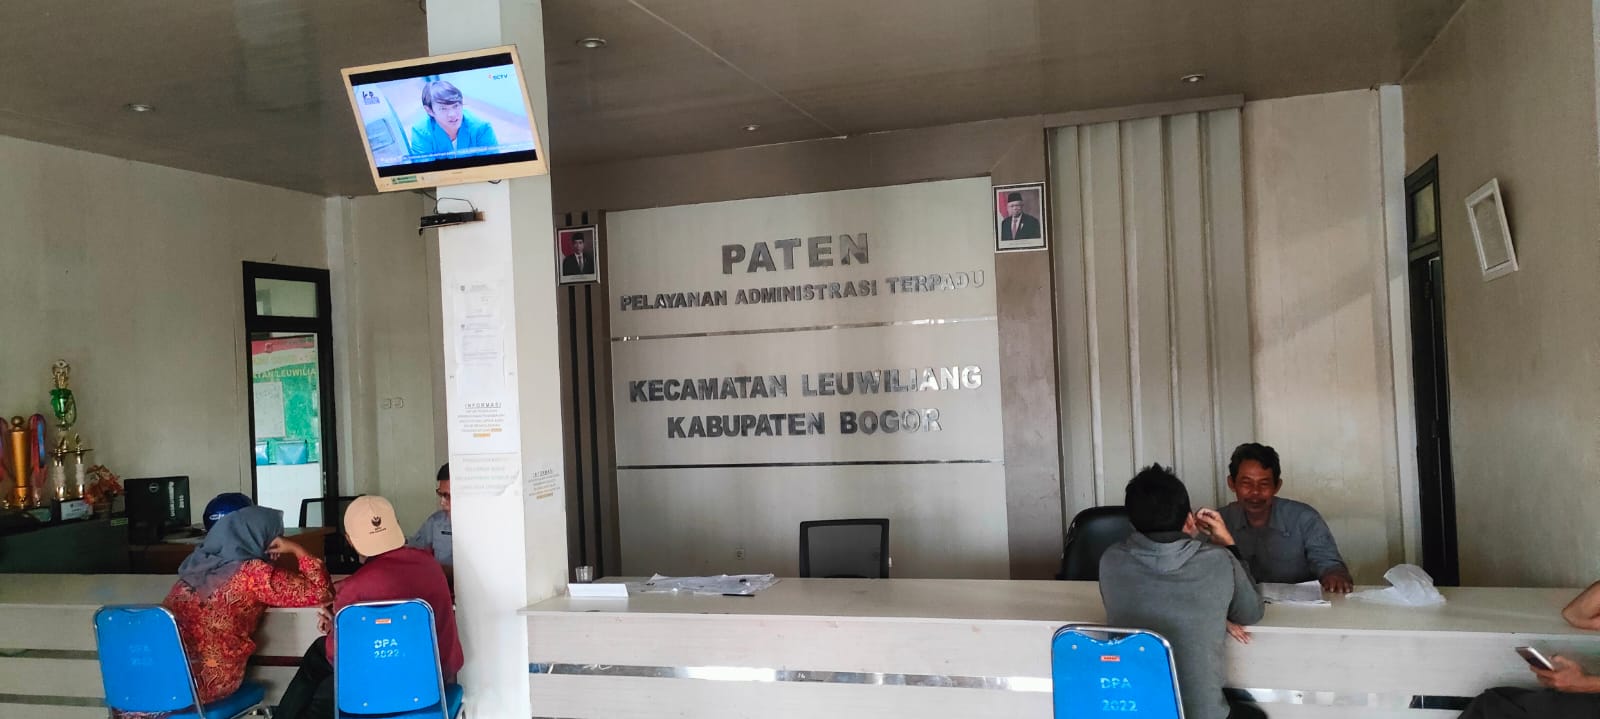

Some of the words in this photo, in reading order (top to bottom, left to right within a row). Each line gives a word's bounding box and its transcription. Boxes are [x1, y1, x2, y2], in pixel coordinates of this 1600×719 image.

[721, 232, 869, 275] PATEN
[620, 289, 728, 311] PELAYANAN
[734, 279, 878, 305] ADMINISTRASI
[885, 269, 985, 296] TERPADU
[628, 374, 788, 403] KECAMATAN
[801, 365, 983, 397] LEUWILIANG
[666, 411, 826, 439] KABUPATEN
[839, 408, 943, 435] BOGOR
[374, 638, 398, 648] DPA
[374, 649, 399, 658] 2022
[1100, 677, 1132, 689] DPA
[1102, 699, 1138, 712] 2022
